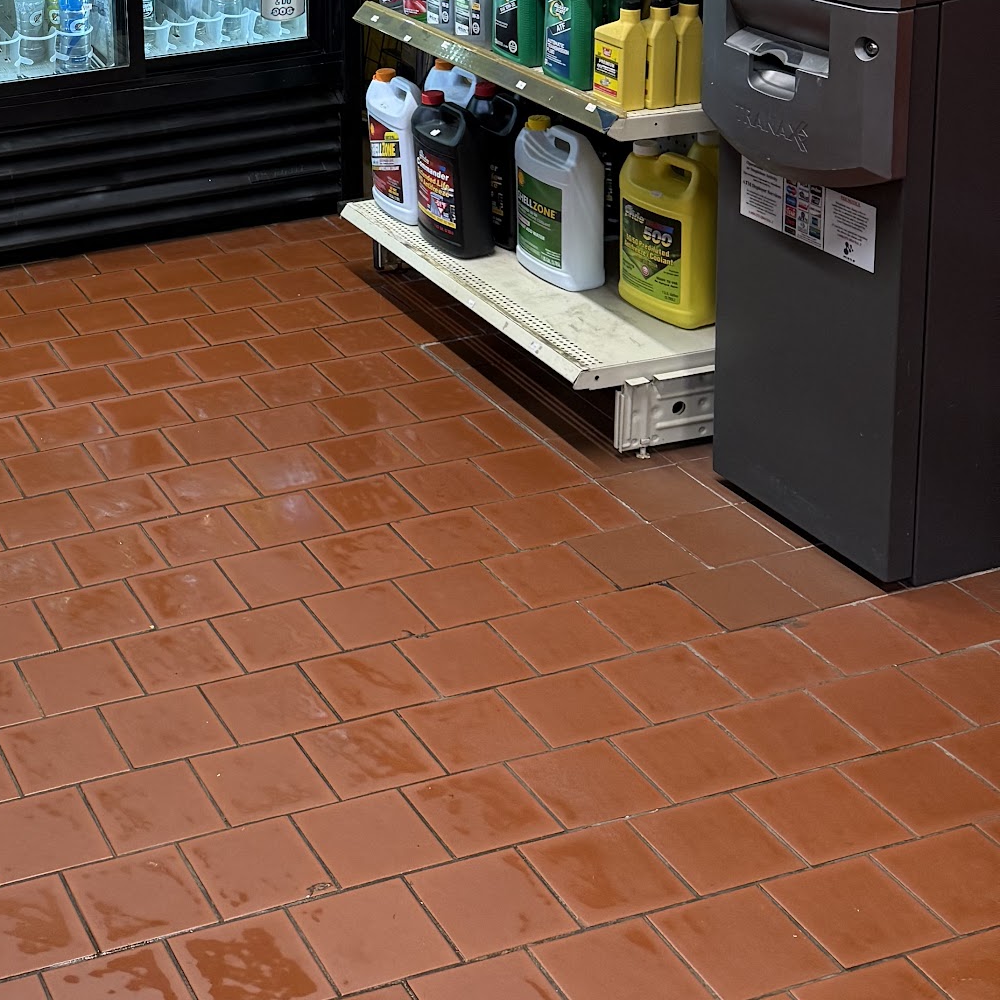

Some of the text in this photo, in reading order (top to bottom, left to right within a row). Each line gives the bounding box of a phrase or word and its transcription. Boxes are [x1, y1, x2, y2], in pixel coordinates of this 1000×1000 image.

[556, 24, 567, 33] ATF
[416, 156, 449, 181] Commander
[642, 226, 673, 248] 500
[649, 251, 675, 266] Coolant
